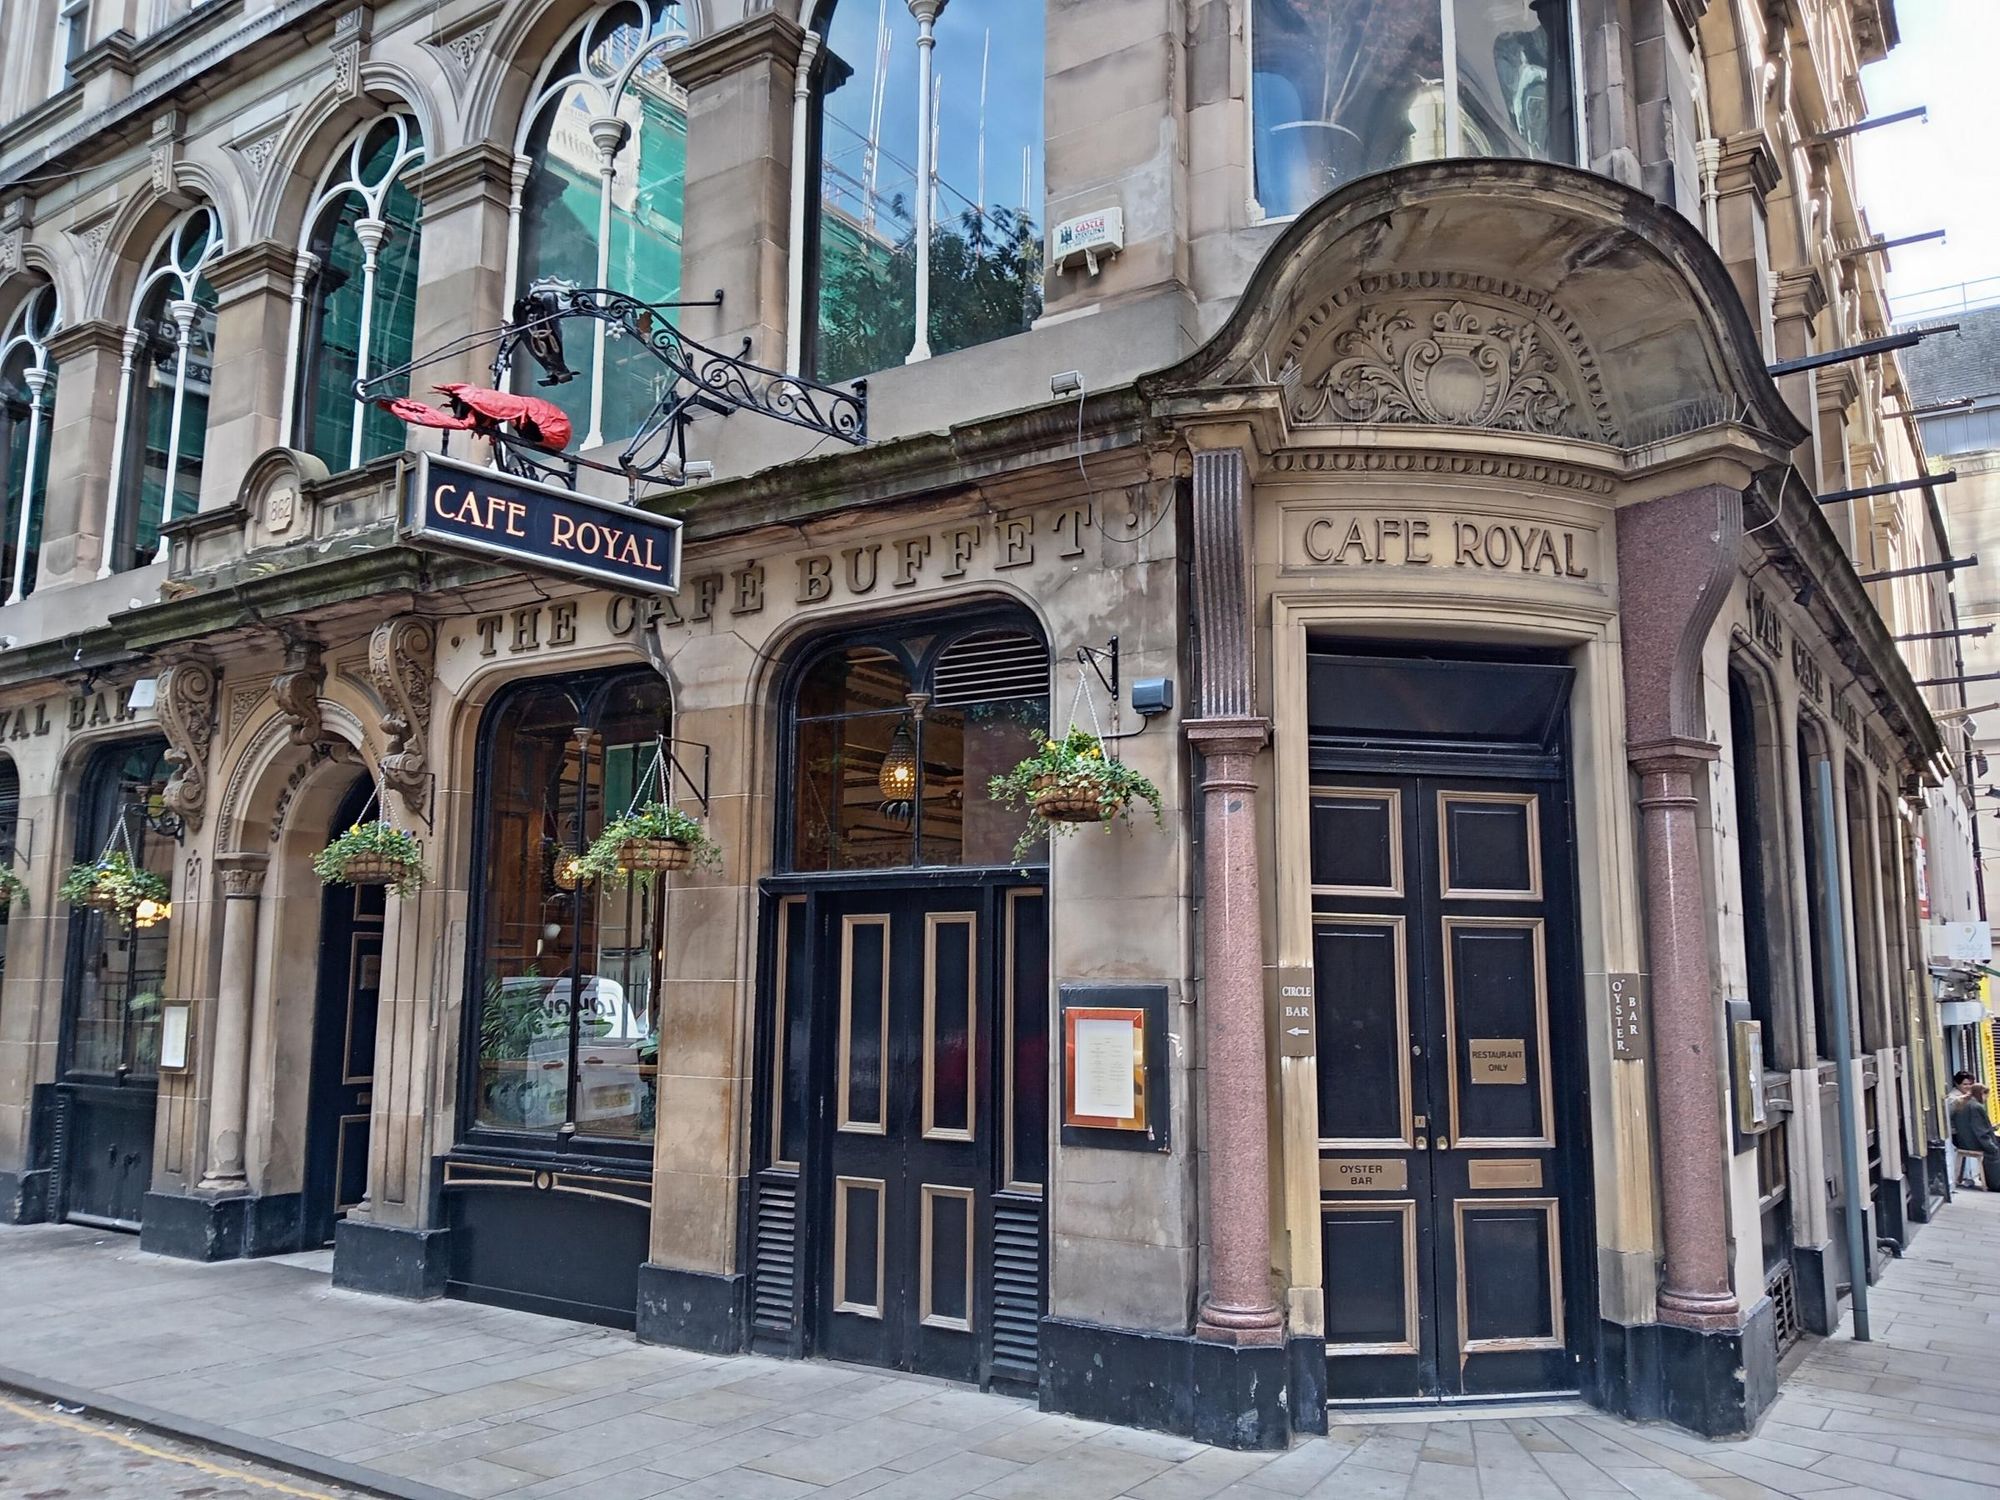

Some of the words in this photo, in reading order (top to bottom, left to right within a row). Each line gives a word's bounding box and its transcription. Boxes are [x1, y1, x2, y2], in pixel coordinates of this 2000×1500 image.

[434, 484, 527, 538] CAFE
[551, 513, 662, 571] ROYAL
[1304, 516, 1433, 564] CAFE
[1453, 519, 1588, 578] ROYAL
[476, 601, 577, 657] THE
[795, 503, 1092, 604] BUFFET
[1281, 986, 1312, 997] CIRCLE
[1285, 1006, 1310, 1017] BAR
[1612, 981, 1625, 1051] OYSTER
[1628, 997, 1639, 1035] BAR
[1472, 1050, 1522, 1059] RESTAURANT
[1488, 1063, 1508, 1072] ONLY
[1340, 1164, 1383, 1174] OYSTER
[1351, 1176, 1373, 1185] BAR
